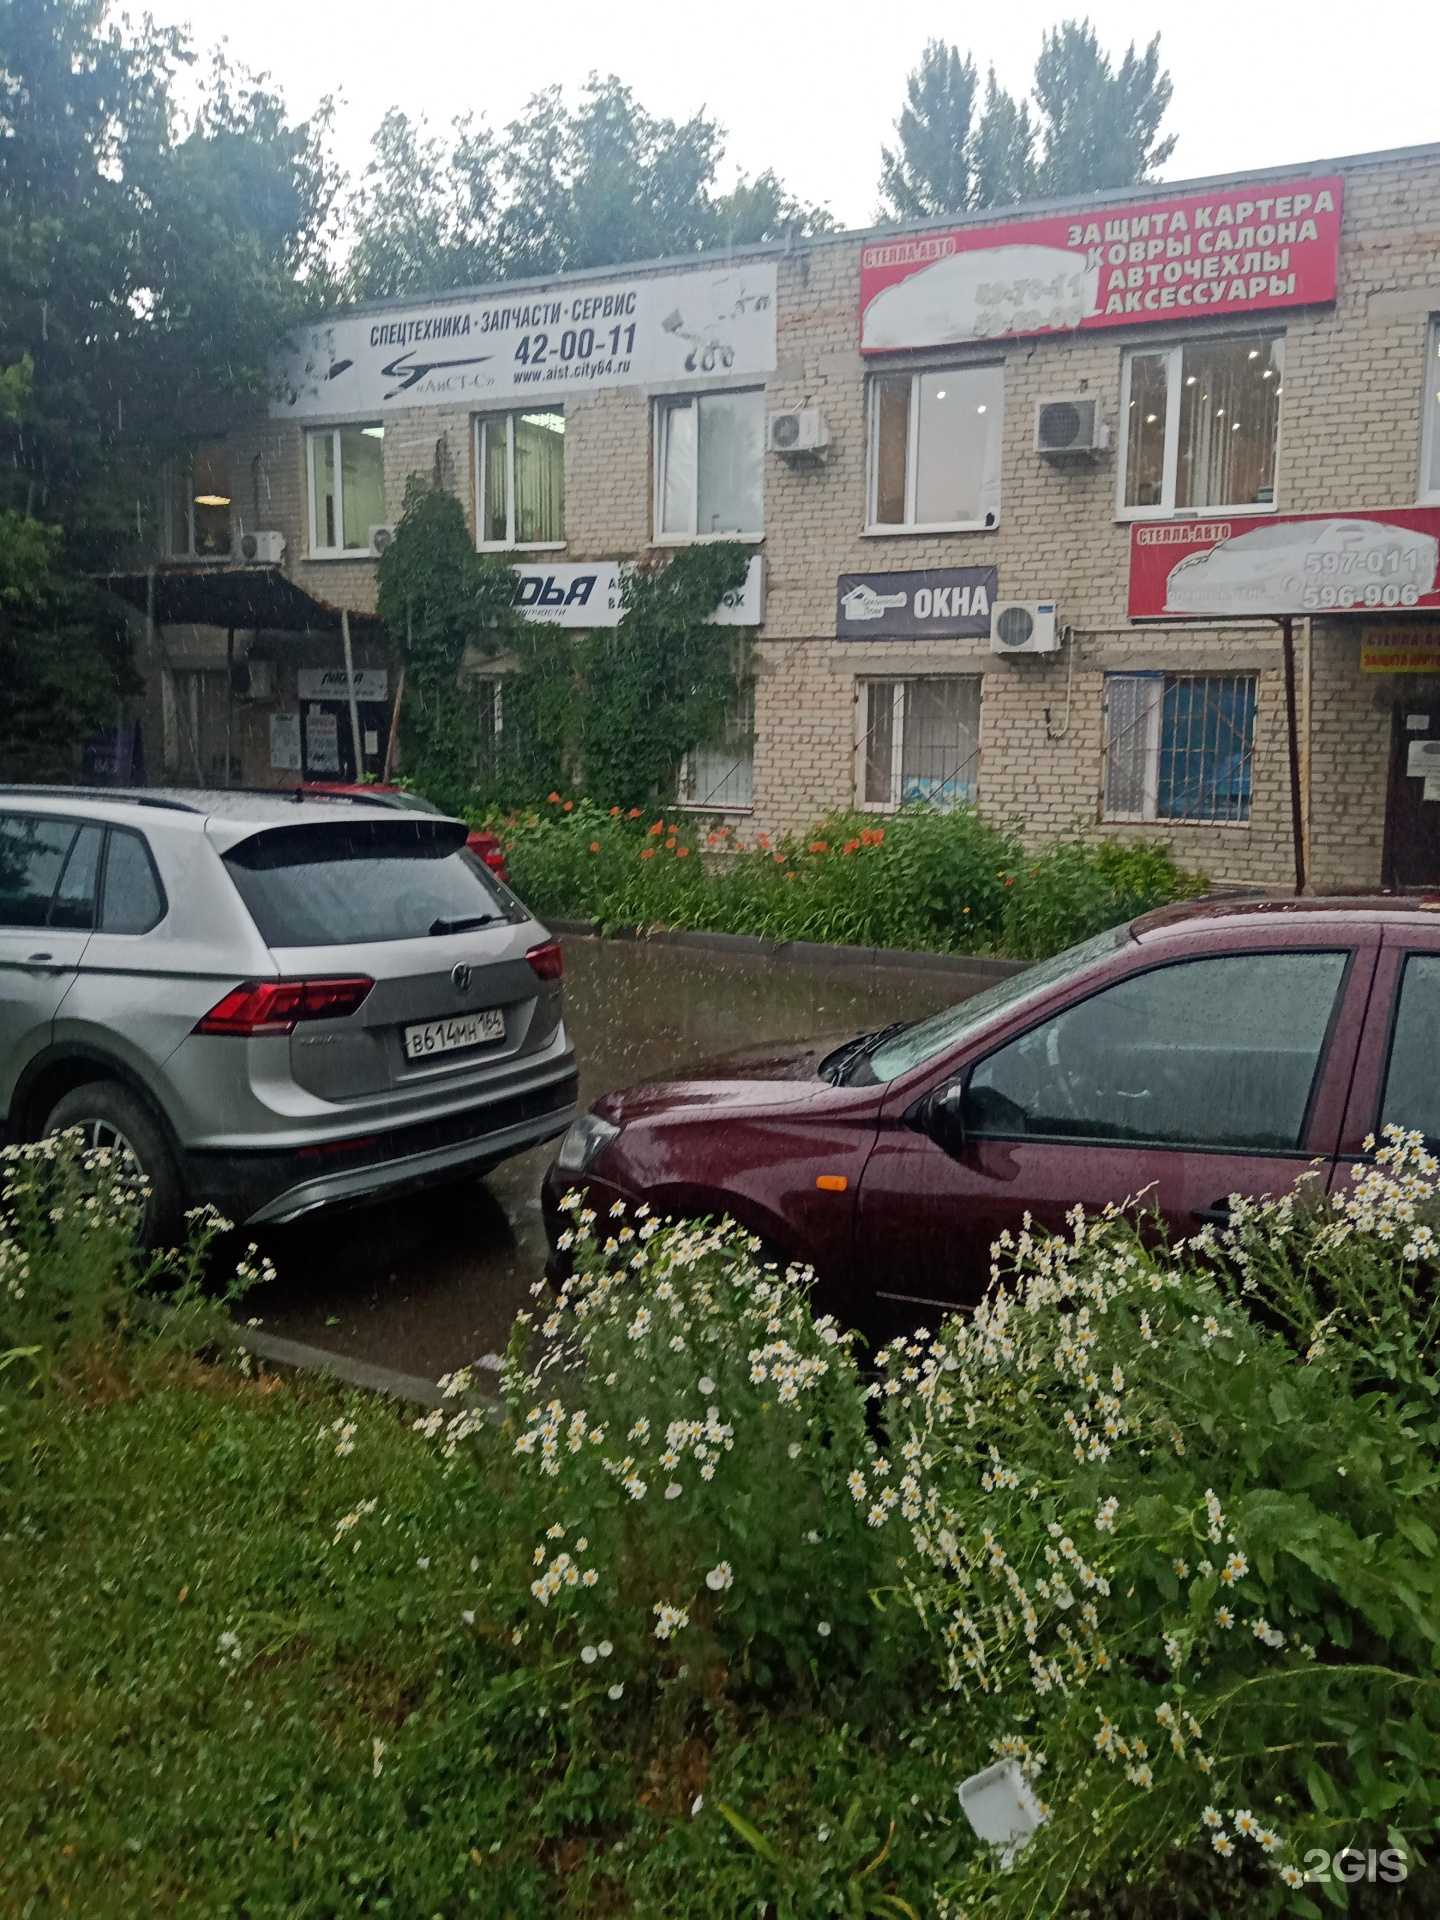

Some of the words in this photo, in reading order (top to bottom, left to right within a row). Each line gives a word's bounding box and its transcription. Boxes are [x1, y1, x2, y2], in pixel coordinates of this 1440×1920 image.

[1067, 210, 1188, 246] ЗАЩИТА
[1194, 190, 1335, 228] КАРТЕРА
[1085, 235, 1192, 269] КОВРЫ
[1198, 219, 1318, 253] САЛОНА
[1107, 248, 1290, 291] АВТОЧЕХЛЫ
[1104, 273, 1297, 315] АКСЕССУАРЫ
[370, 314, 471, 347] СПЕЦТЕХНИКА
[480, 302, 562, 333] ЗАПЧАСТИ
[571, 292, 637, 321] СЕРВИС
[514, 322, 637, 365] 42-00-11
[513, 360, 631, 384] www.aist.city64.ru
[1303, 547, 1418, 575] 597-011
[913, 585, 990, 619] ОКНА
[1302, 583, 1420, 609] 596-906
